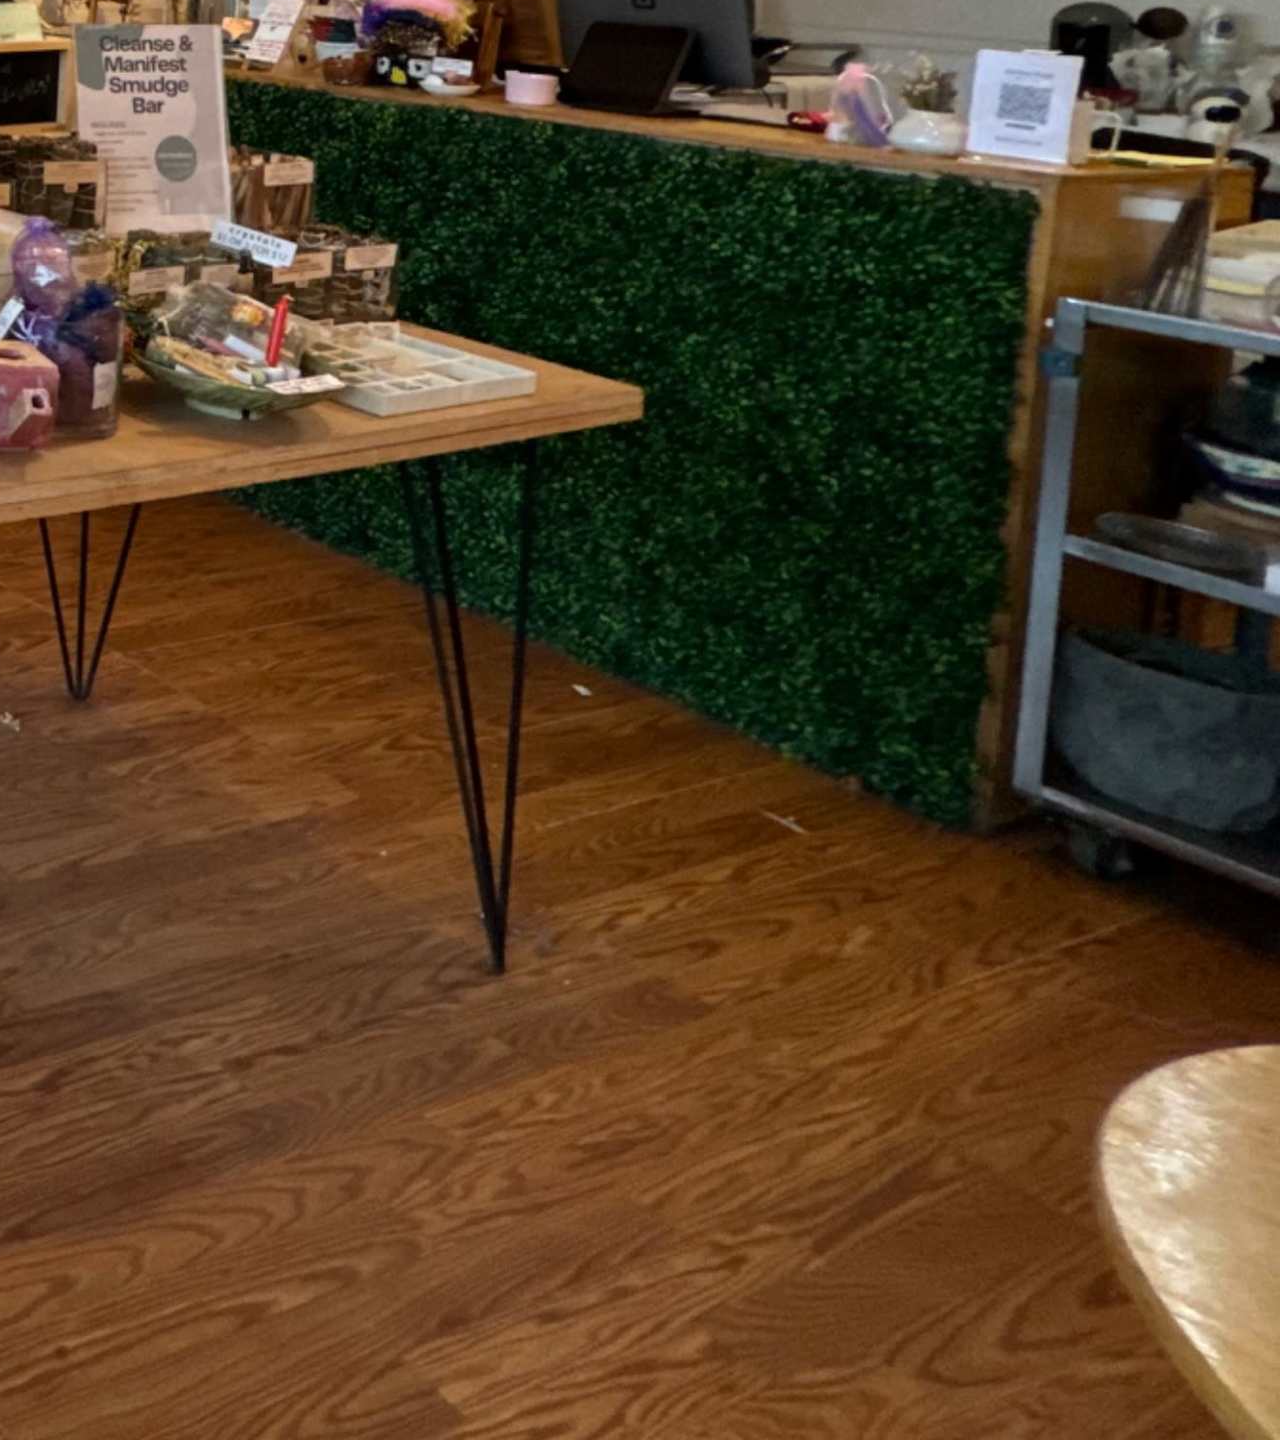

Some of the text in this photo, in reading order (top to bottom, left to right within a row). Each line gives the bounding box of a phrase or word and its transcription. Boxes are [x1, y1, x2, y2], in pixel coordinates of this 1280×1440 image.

[99, 35, 193, 53] Cleanse &
[103, 55, 187, 72] Manifest
[109, 76, 189, 97] Smudge
[132, 97, 164, 114] Bar
